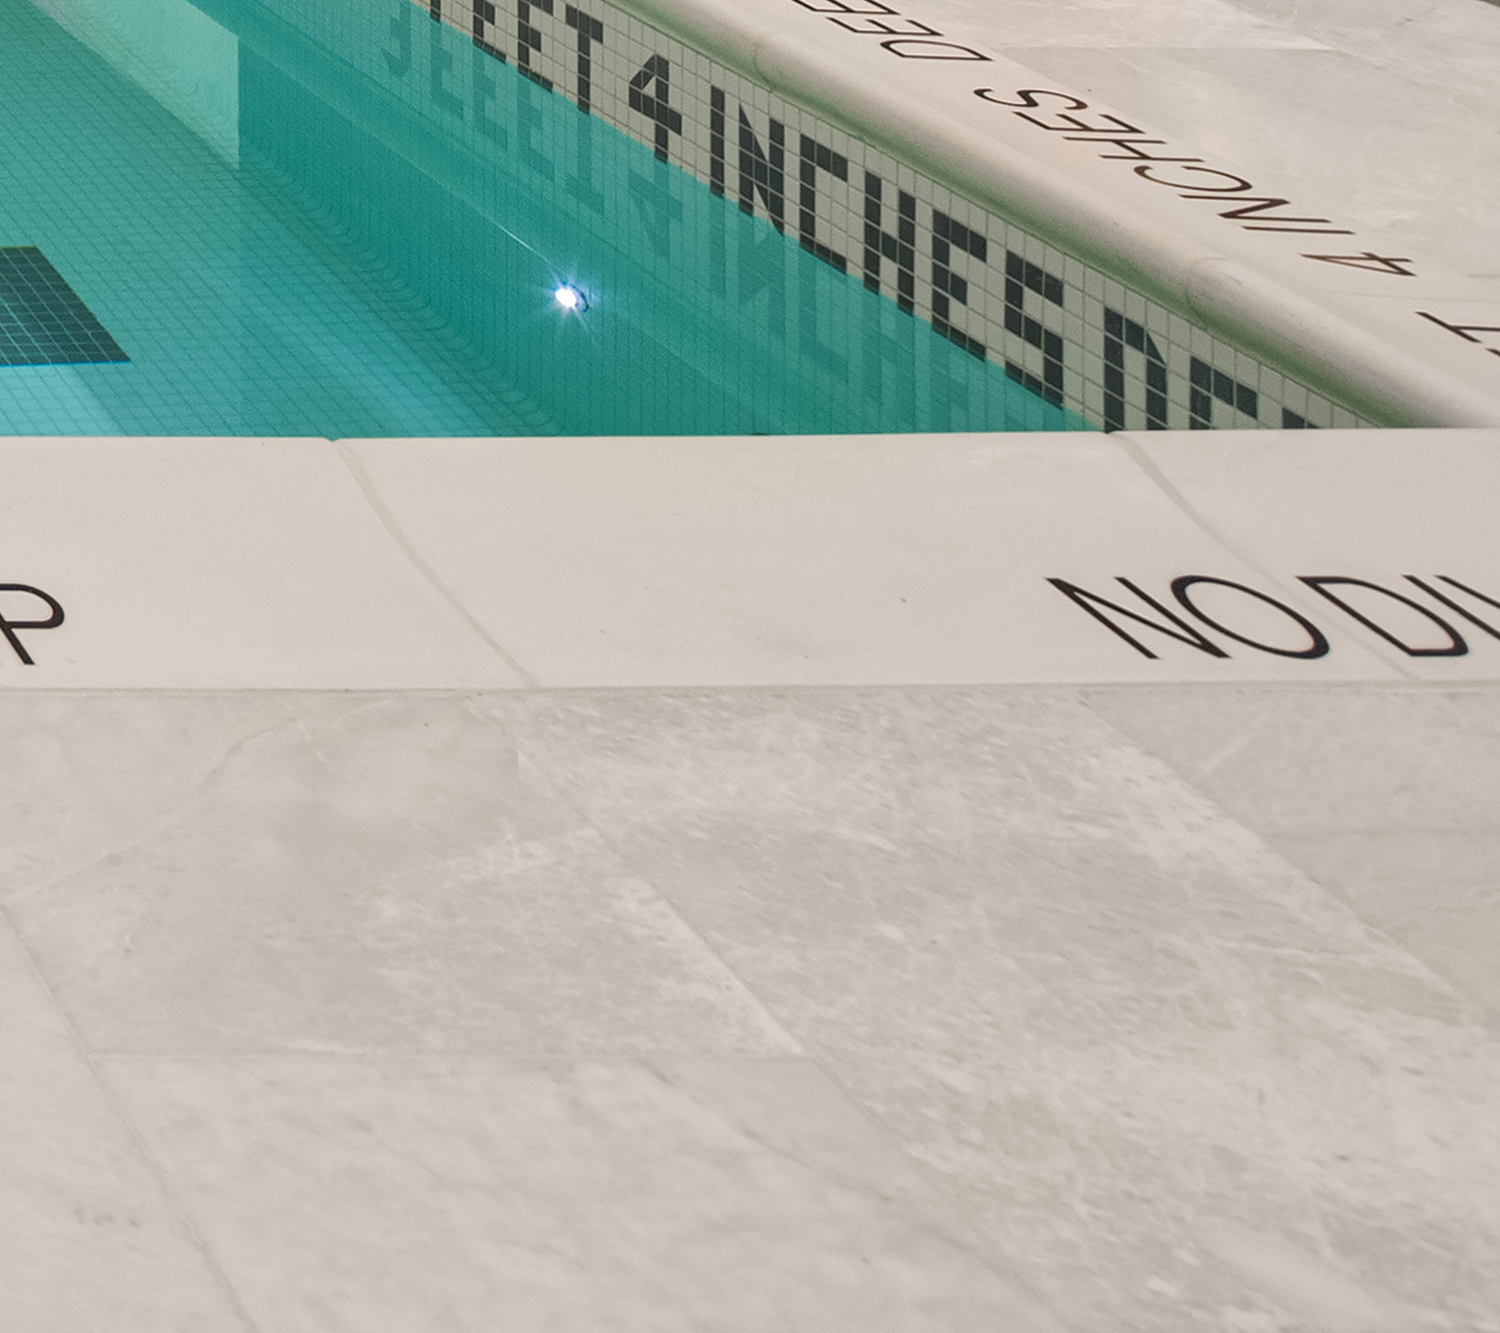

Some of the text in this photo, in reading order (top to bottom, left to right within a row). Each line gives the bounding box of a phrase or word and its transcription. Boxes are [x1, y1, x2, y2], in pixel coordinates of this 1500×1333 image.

[628, 53, 683, 164] 4
[710, 85, 1064, 409] INCHES
[972, 87, 1356, 235] INCHES
[1299, 251, 1417, 277] 4
